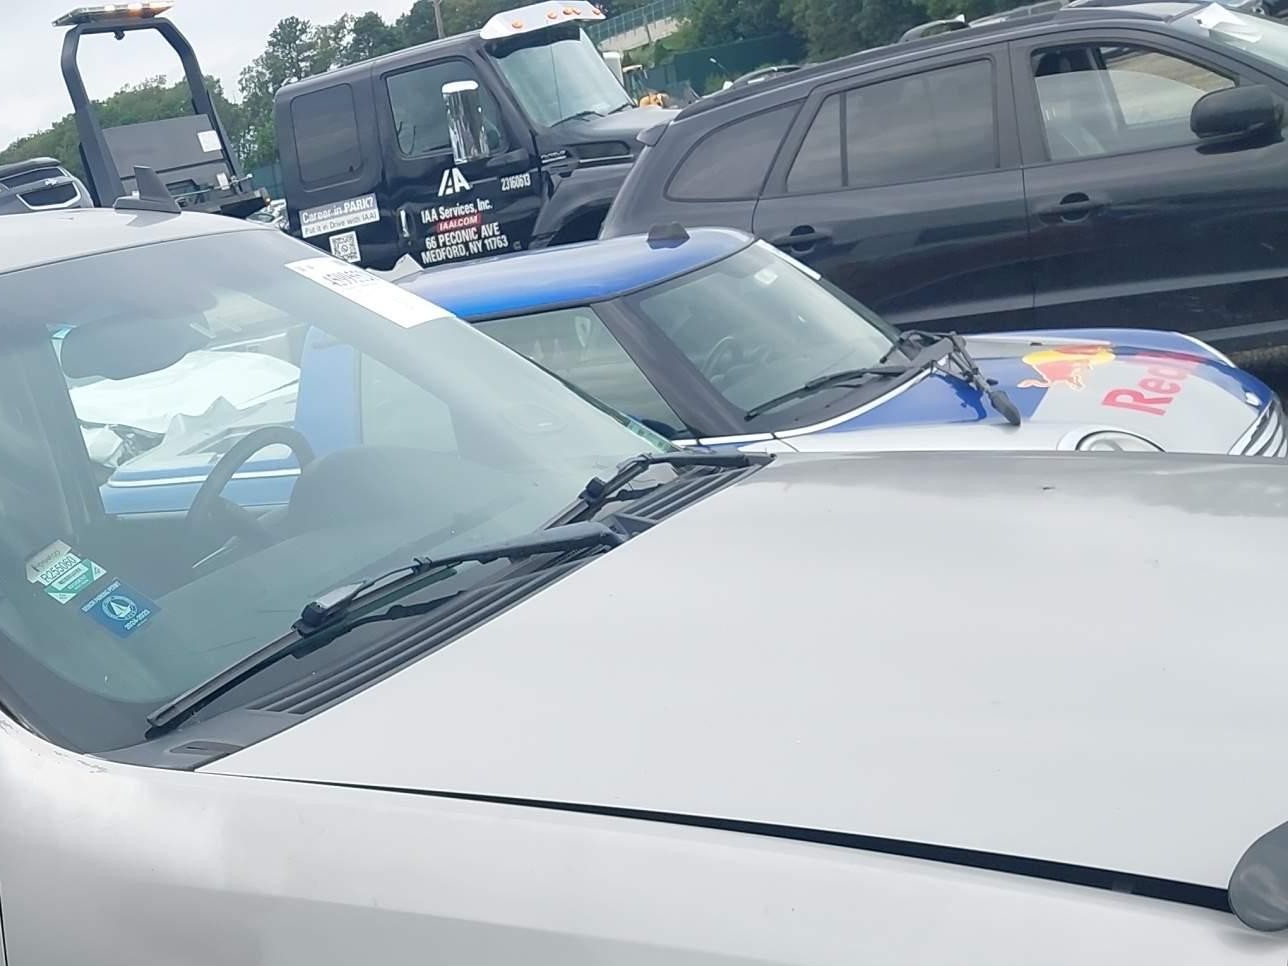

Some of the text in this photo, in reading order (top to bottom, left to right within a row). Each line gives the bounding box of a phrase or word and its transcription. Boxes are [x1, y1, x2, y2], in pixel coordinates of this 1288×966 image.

[302, 197, 374, 223] Career in PARK?
[421, 198, 493, 223] IAA Services, Inc.
[439, 215, 478, 231] IAAI.COM
[425, 222, 500, 249] 66 PECONIC AVE
[421, 235, 508, 264] MEDFORD, NY 11763
[1101, 354, 1198, 416] Red
